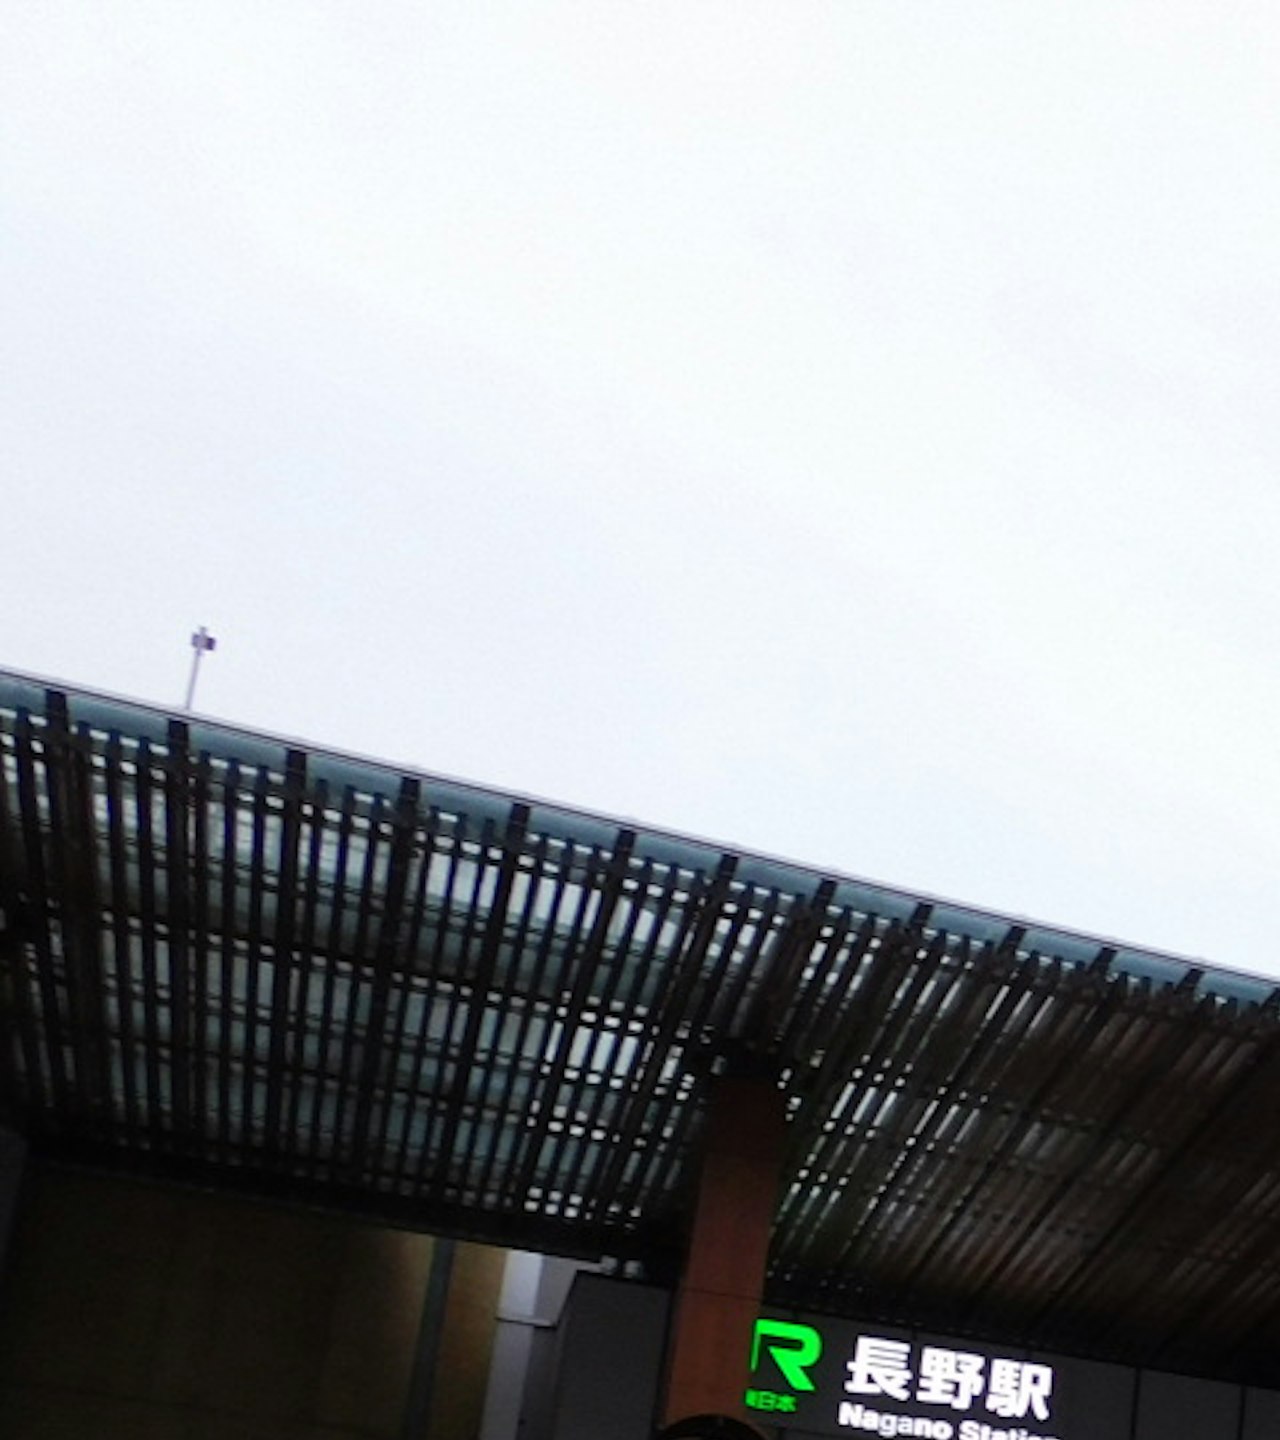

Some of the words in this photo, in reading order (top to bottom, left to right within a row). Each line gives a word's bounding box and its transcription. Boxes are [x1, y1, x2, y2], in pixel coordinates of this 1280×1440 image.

[843, 1335, 1053, 1421] 長野駅
[838, 1401, 953, 1440] Nagano
